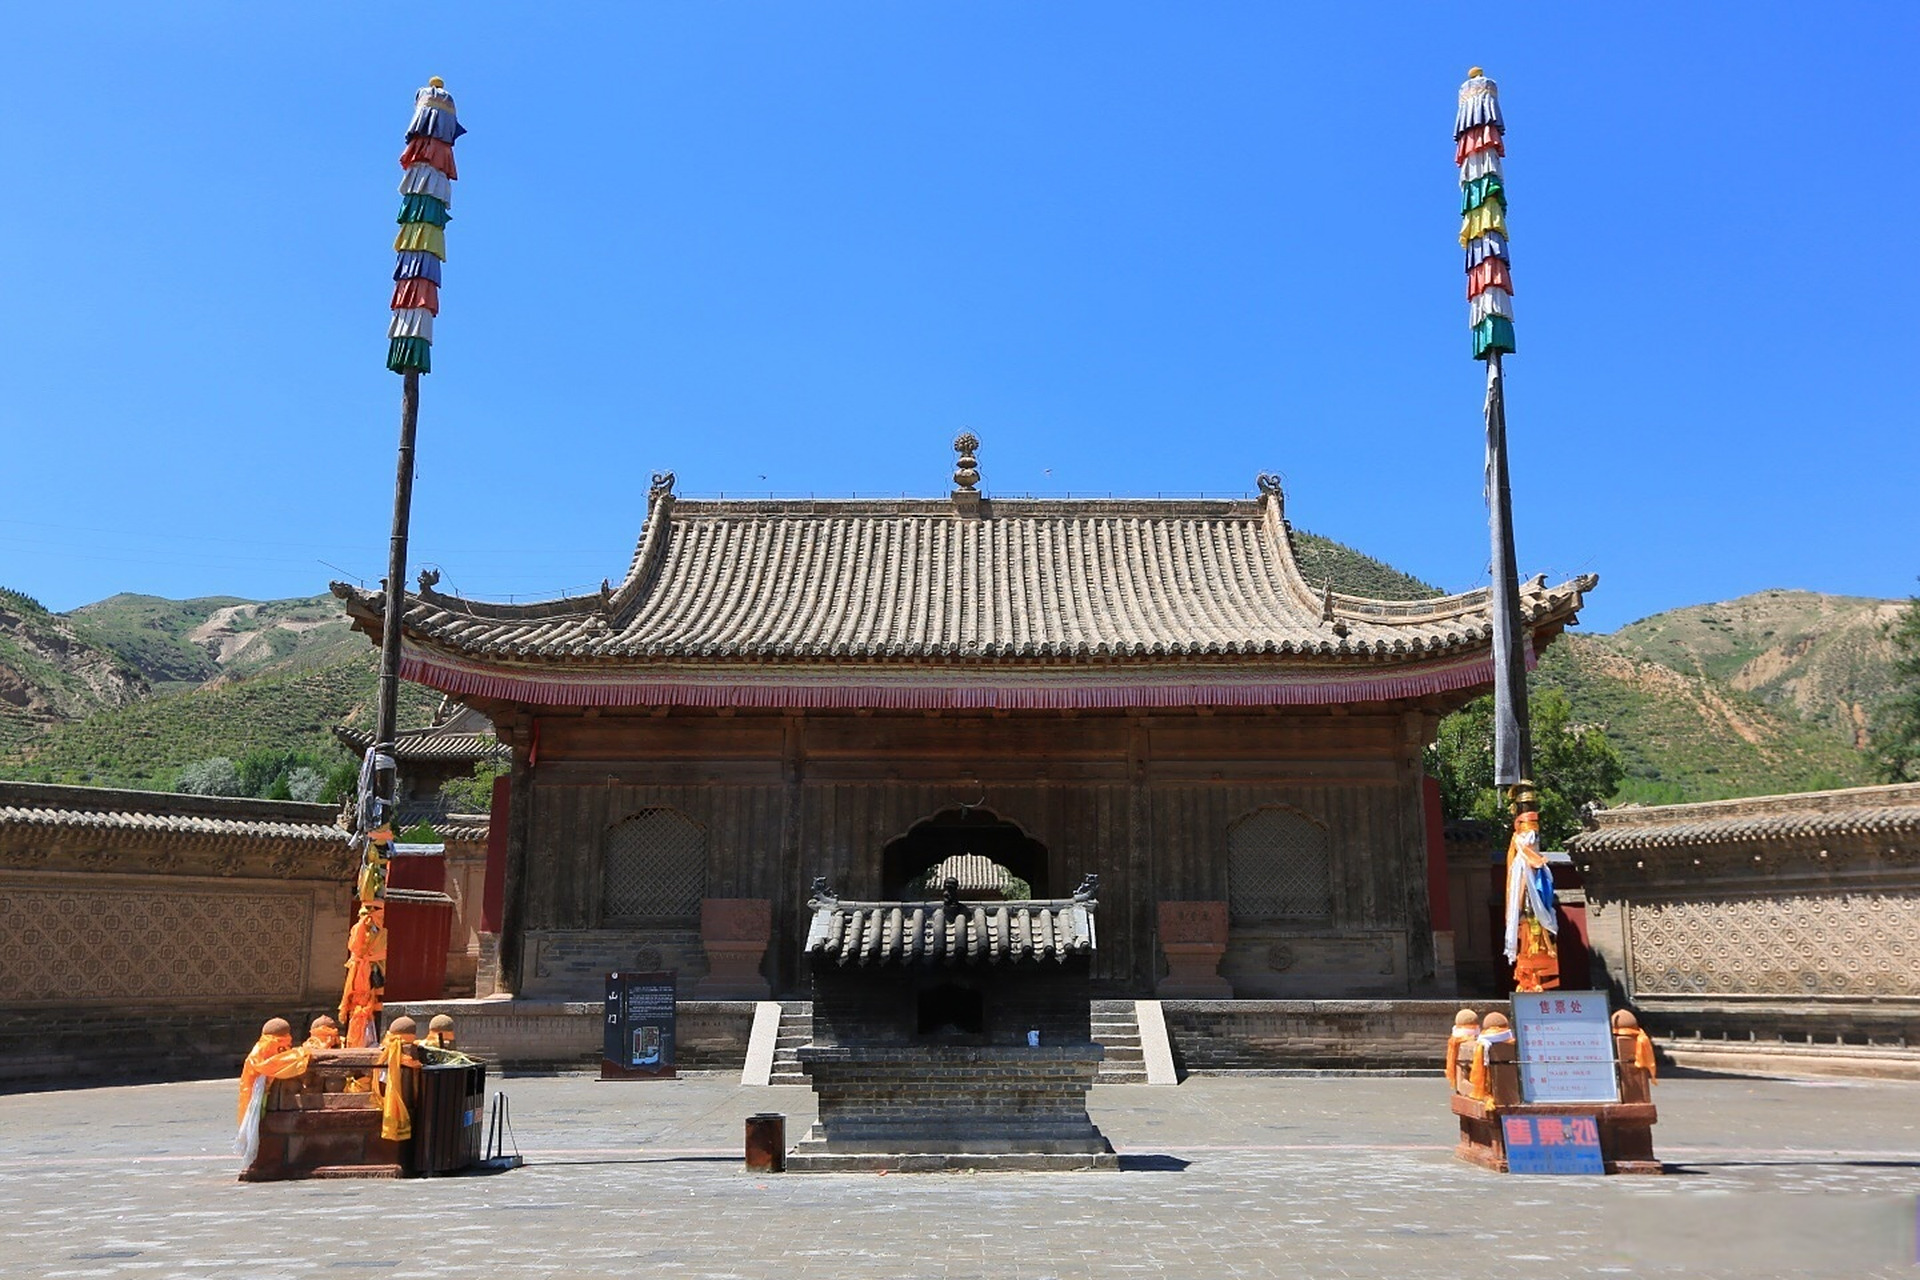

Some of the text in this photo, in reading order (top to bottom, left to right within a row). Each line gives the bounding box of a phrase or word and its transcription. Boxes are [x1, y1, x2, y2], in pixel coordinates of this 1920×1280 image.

[1539, 1000, 1582, 1014] 售票处
[1505, 1118, 1599, 1146] 售票处
